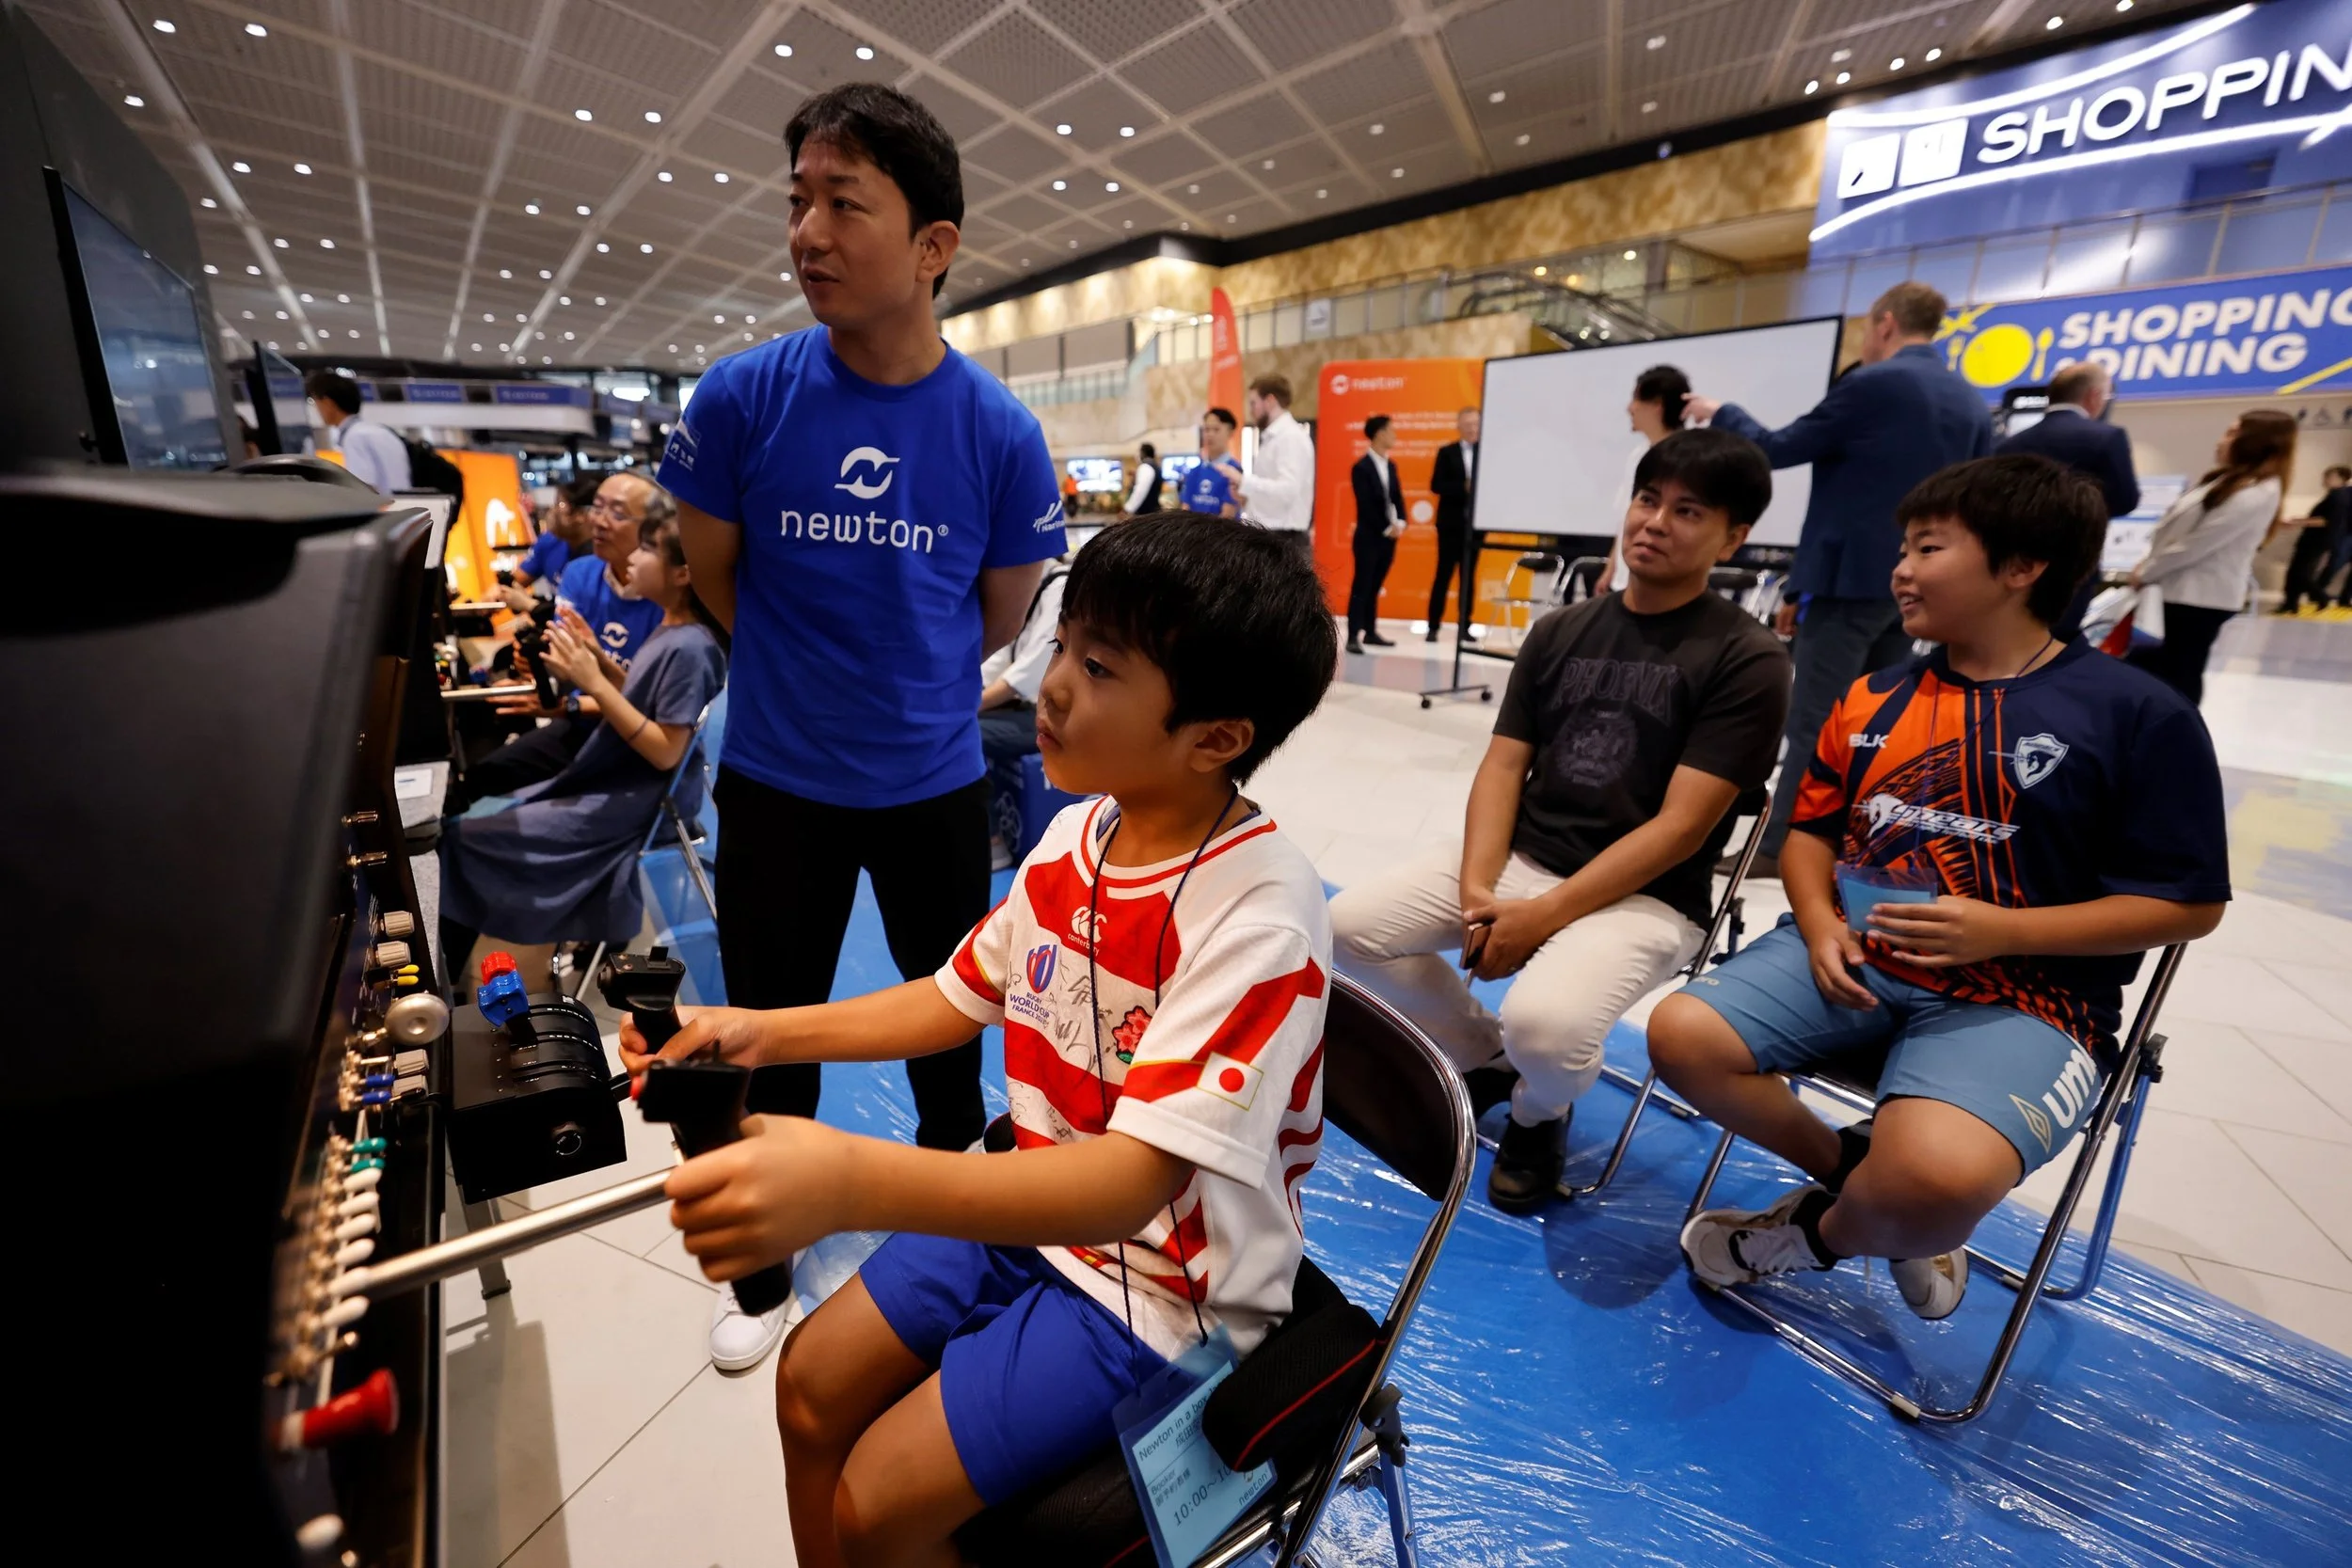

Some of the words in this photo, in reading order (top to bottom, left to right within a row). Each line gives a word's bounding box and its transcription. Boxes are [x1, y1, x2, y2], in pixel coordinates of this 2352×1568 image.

[1977, 38, 2352, 164] SHOPPIN
[1849, 733, 1889, 749] BLK
[1068, 933, 1100, 957] canterbry
[1009, 993, 1040, 1012] WORLD
[1040, 1006, 1050, 1018] CUP
[1012, 1005, 1035, 1020] FRANCE
[1138, 1426, 1174, 1462] Newton
[1174, 1418, 1184, 1431] in
[1185, 1411, 1191, 1420] a
